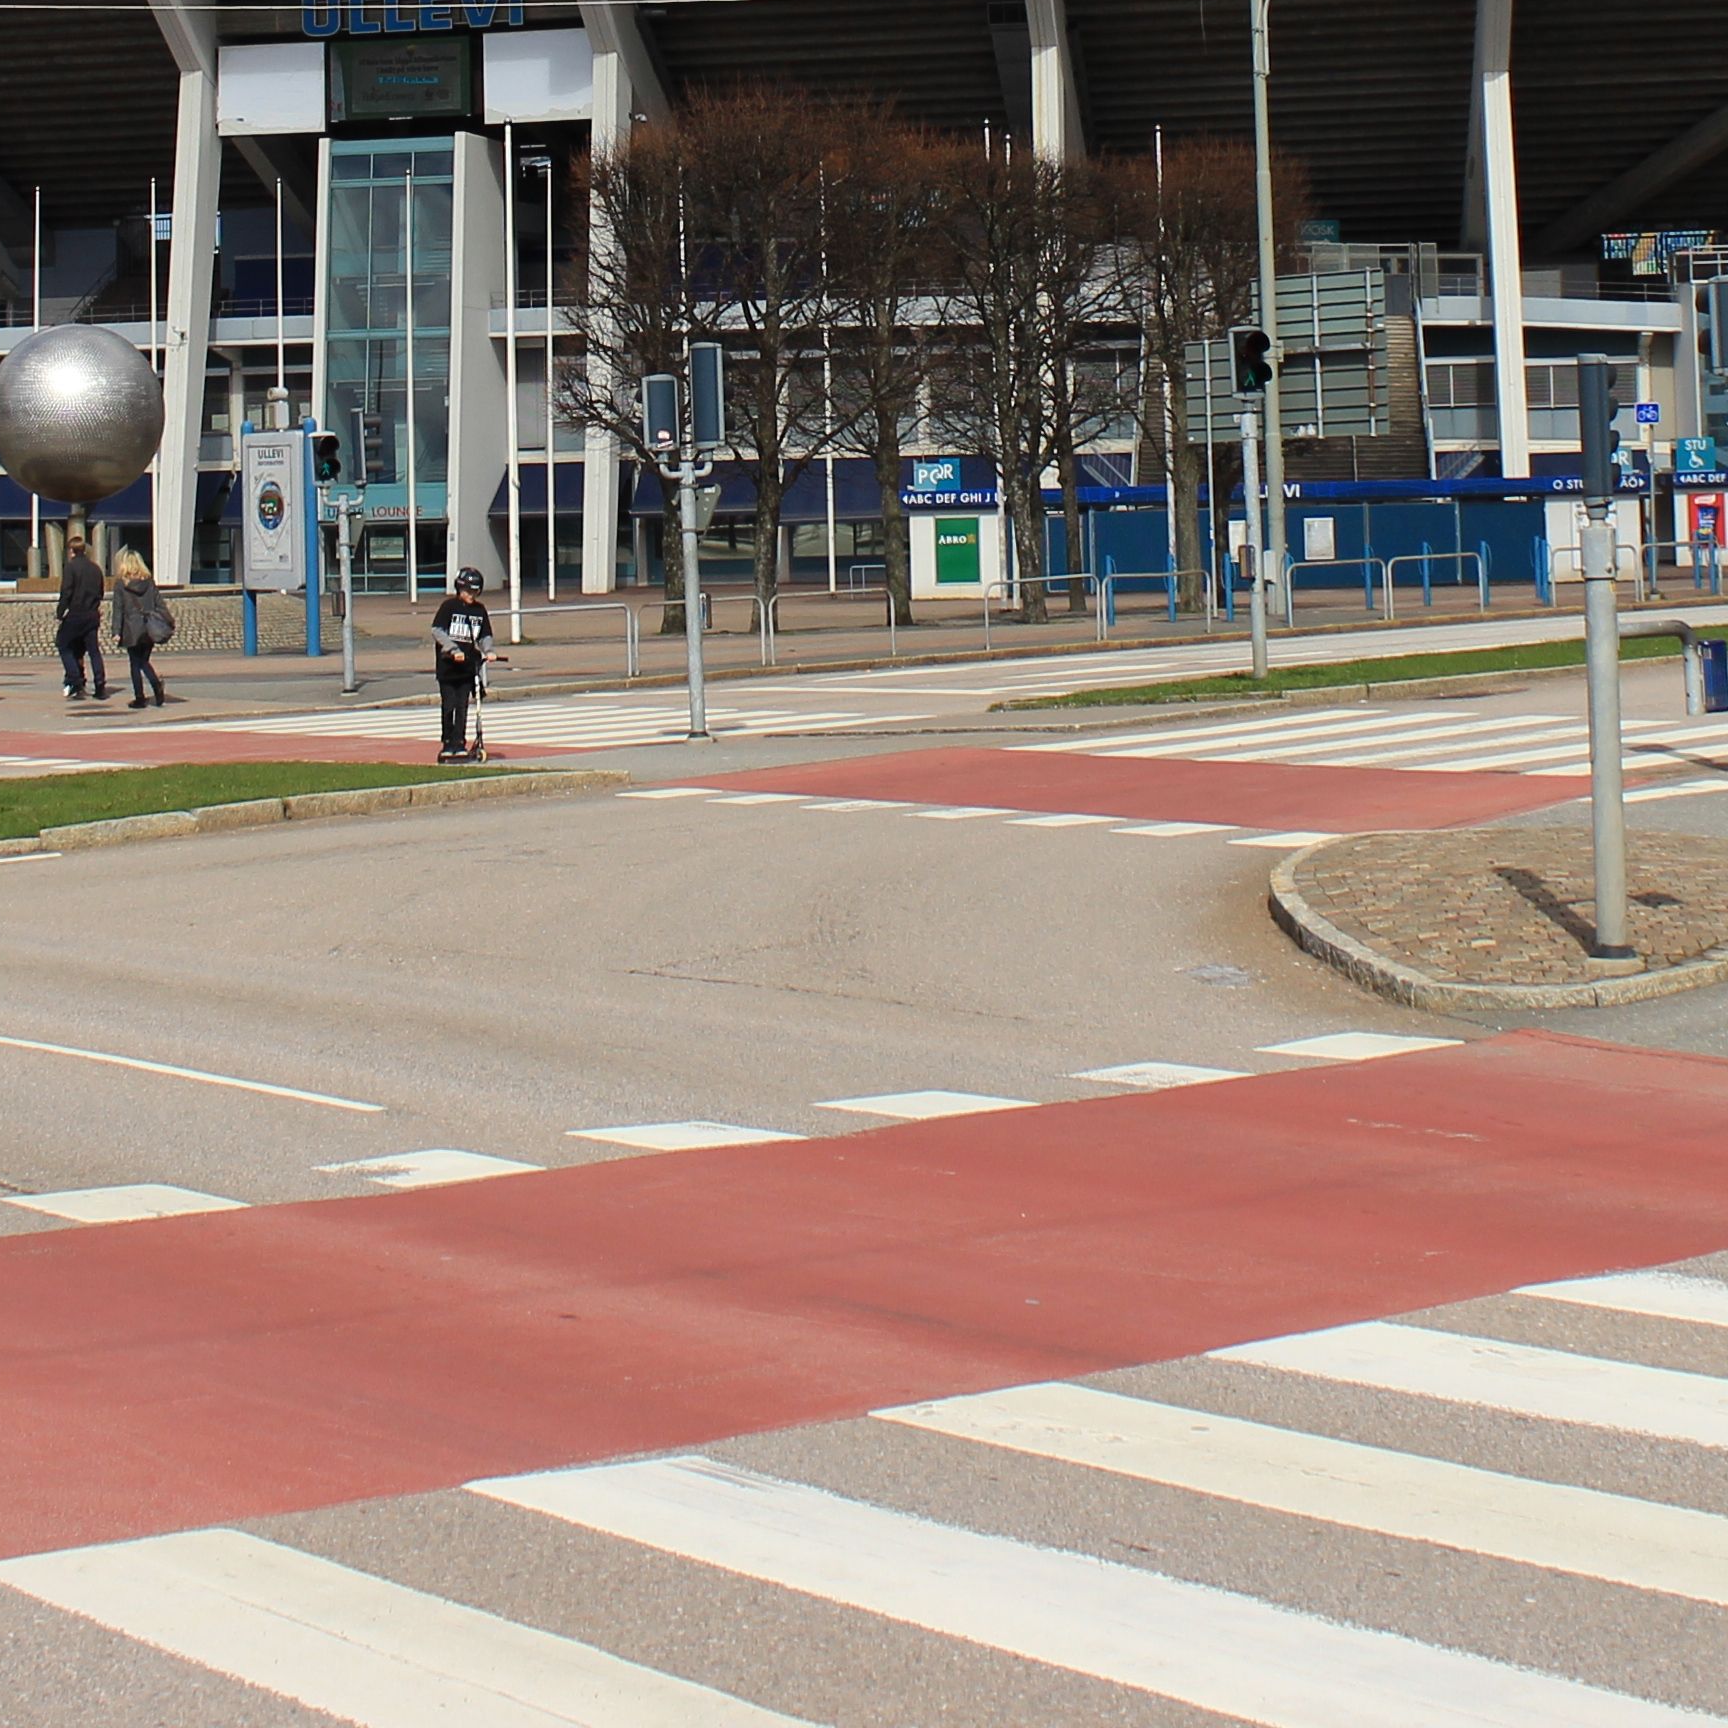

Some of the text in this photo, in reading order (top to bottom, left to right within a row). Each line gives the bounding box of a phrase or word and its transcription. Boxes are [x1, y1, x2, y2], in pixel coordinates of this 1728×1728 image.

[1684, 439, 1707, 451] STU
[257, 448, 284, 460] ULLEVI
[917, 463, 954, 485] PQR
[1685, 473, 1707, 483] ABC
[909, 493, 932, 504] ABC
[935, 493, 957, 504] DEF
[960, 492, 982, 503] GHI
